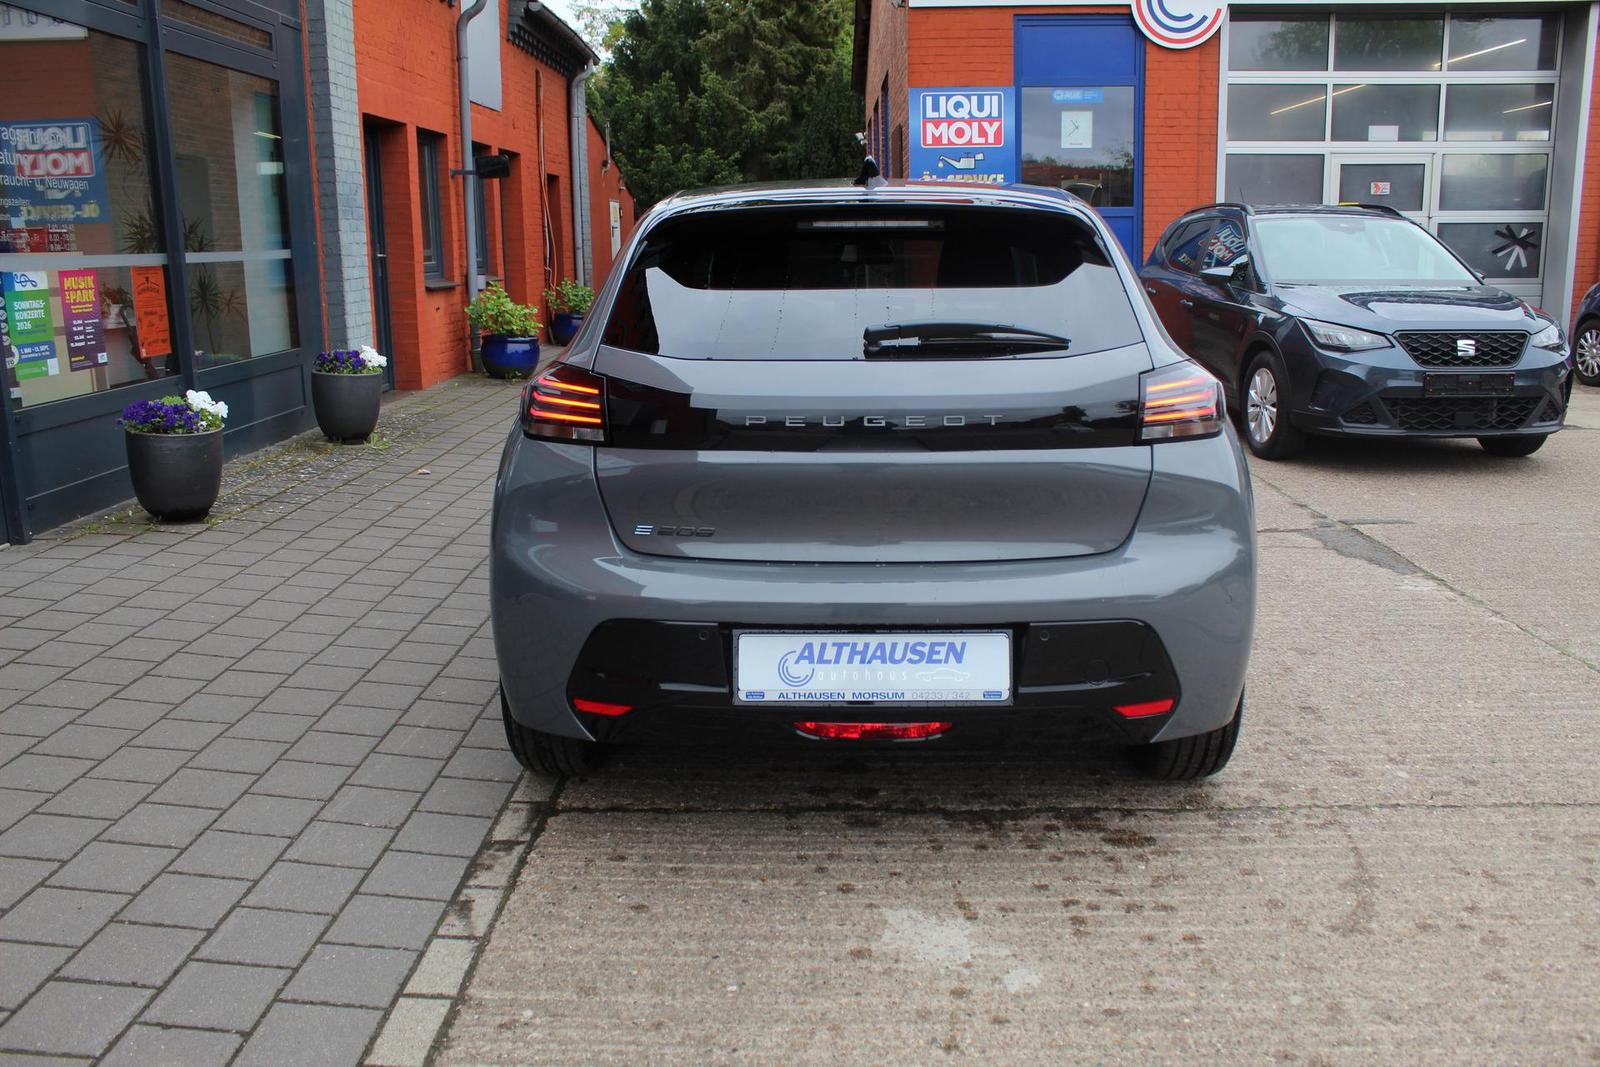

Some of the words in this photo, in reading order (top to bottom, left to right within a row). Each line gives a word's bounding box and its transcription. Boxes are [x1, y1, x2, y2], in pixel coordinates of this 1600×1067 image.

[925, 94, 999, 119] LIQUI
[925, 121, 1001, 145] MOLY
[45, 178, 89, 193] Neuwagen
[64, 276, 95, 289] MUSIK
[16, 321, 32, 331] 2026
[745, 414, 1004, 427] PEUGEOT
[657, 525, 716, 537] 208
[795, 641, 967, 665] ALTHAUSEN
[817, 667, 907, 682] autohaus
[777, 691, 845, 700] ALTHAUSEN
[851, 691, 905, 700] MORSUM
